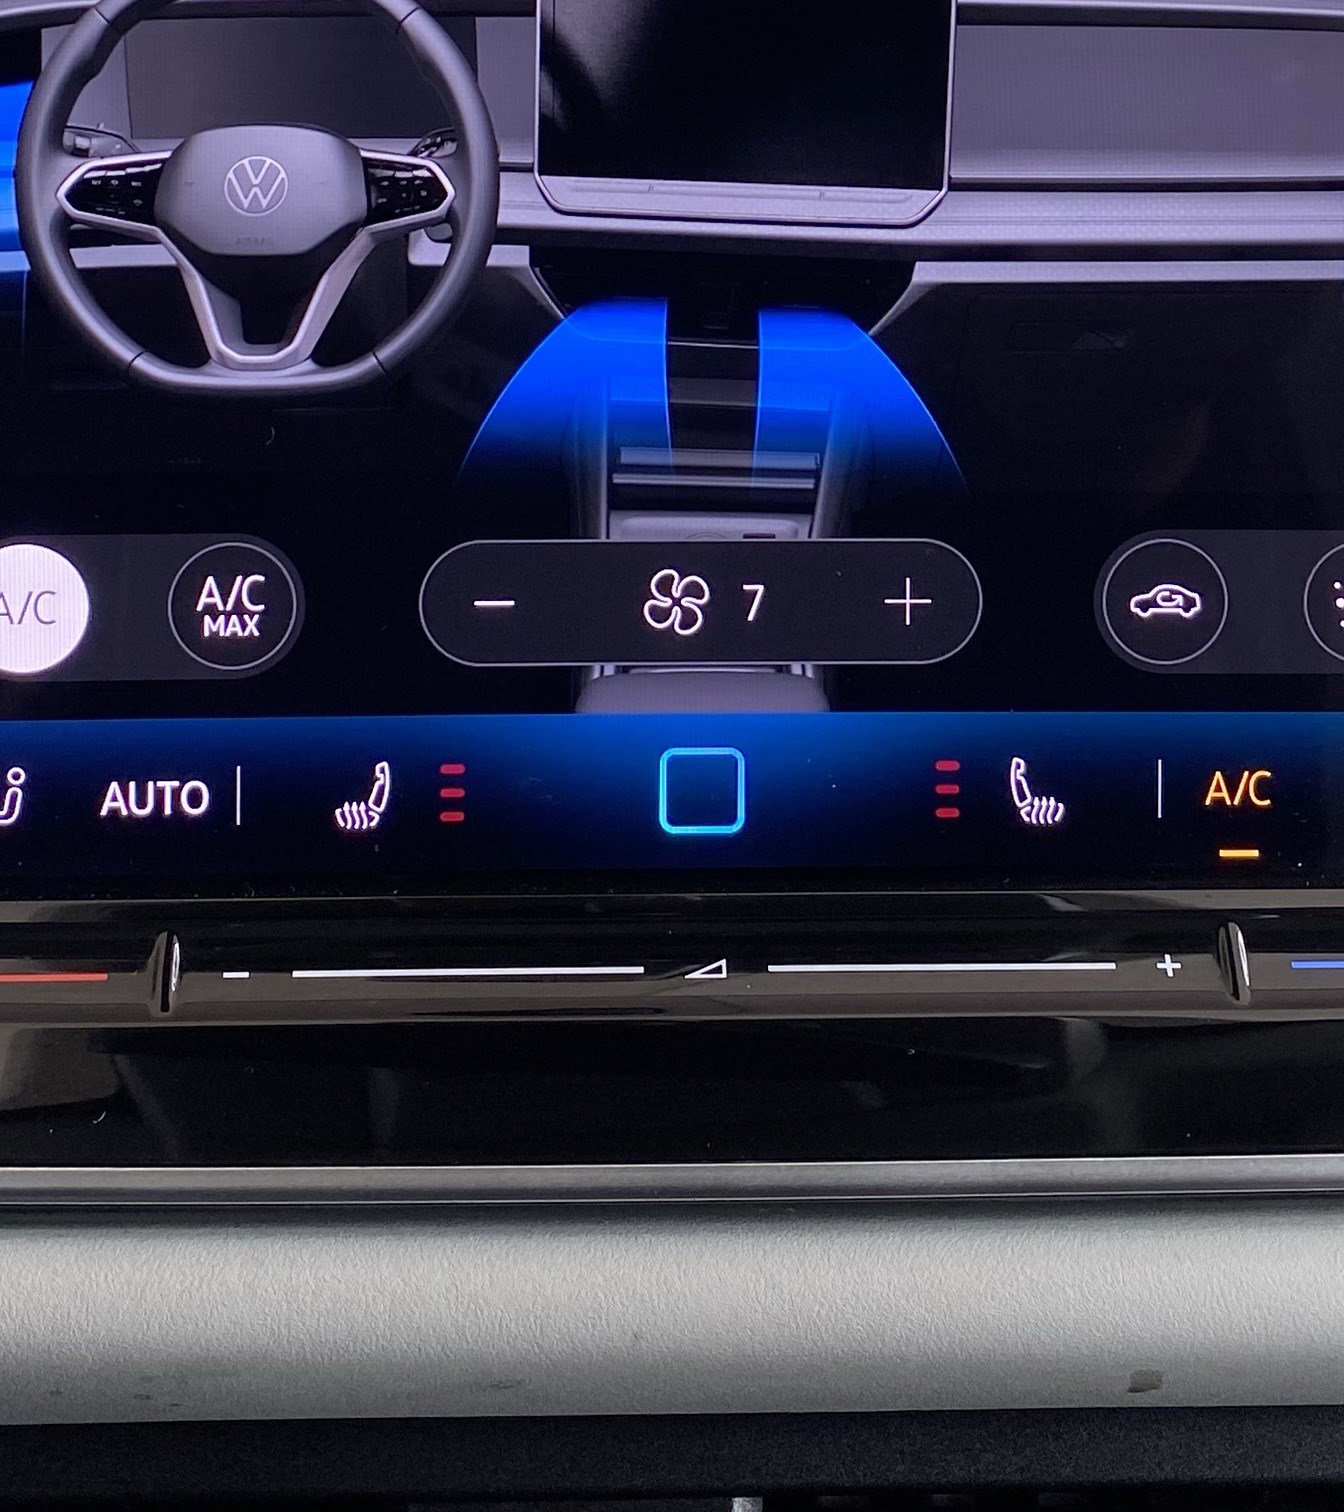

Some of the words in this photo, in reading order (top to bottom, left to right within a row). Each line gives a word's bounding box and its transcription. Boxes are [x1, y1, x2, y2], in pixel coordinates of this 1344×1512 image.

[196, 574, 267, 614] A/C
[742, 584, 766, 622] 7
[203, 613, 261, 638] MAX
[100, 779, 210, 817] AUTO
[1204, 769, 1272, 807] A/C
